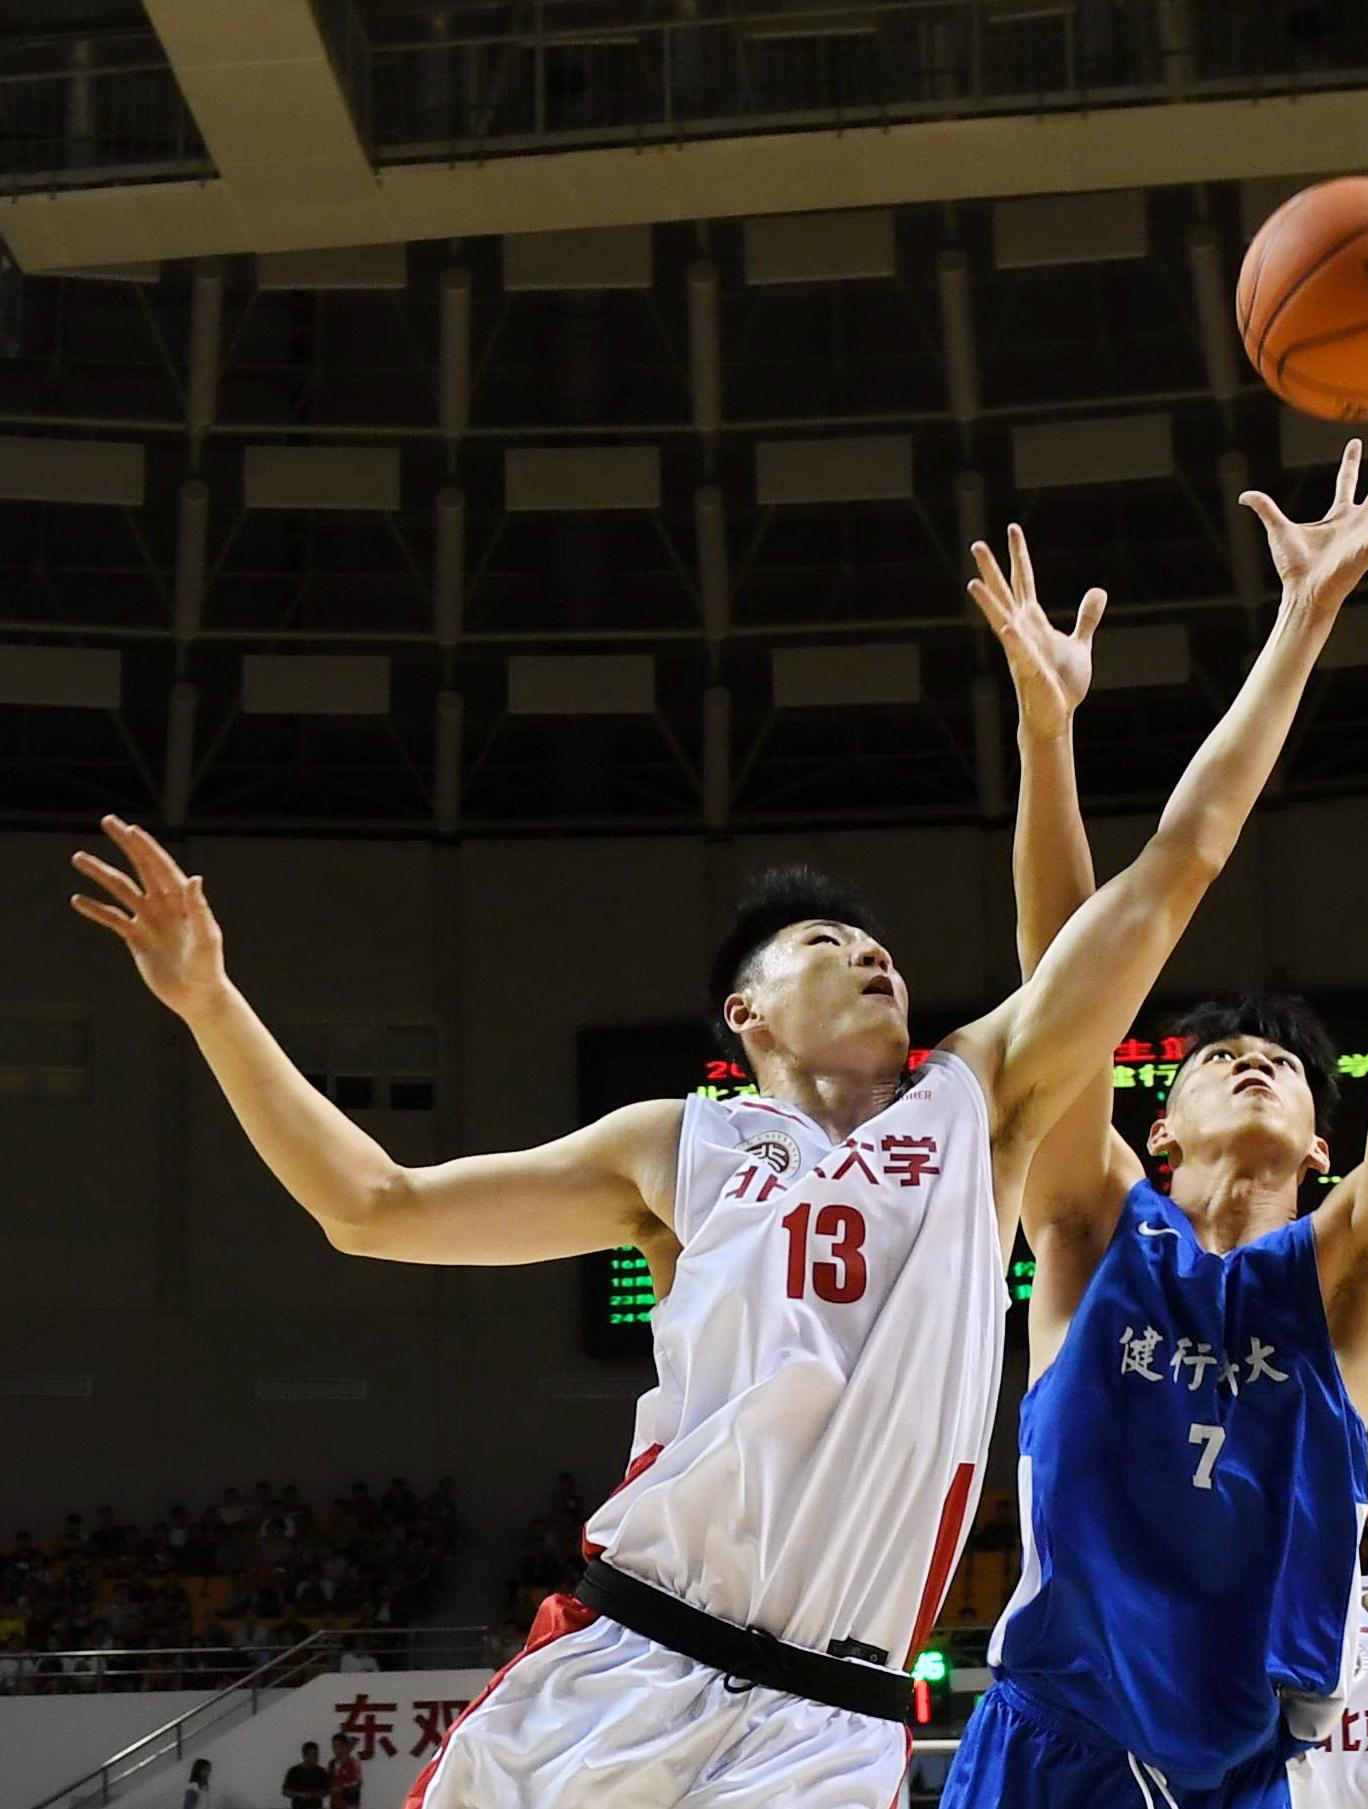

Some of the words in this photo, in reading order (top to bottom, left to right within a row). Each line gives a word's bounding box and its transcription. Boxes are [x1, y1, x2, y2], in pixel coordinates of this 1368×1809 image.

[722, 1134, 941, 1203] 北大学
[782, 1203, 868, 1304] 13
[1188, 1423, 1226, 1489] 7
